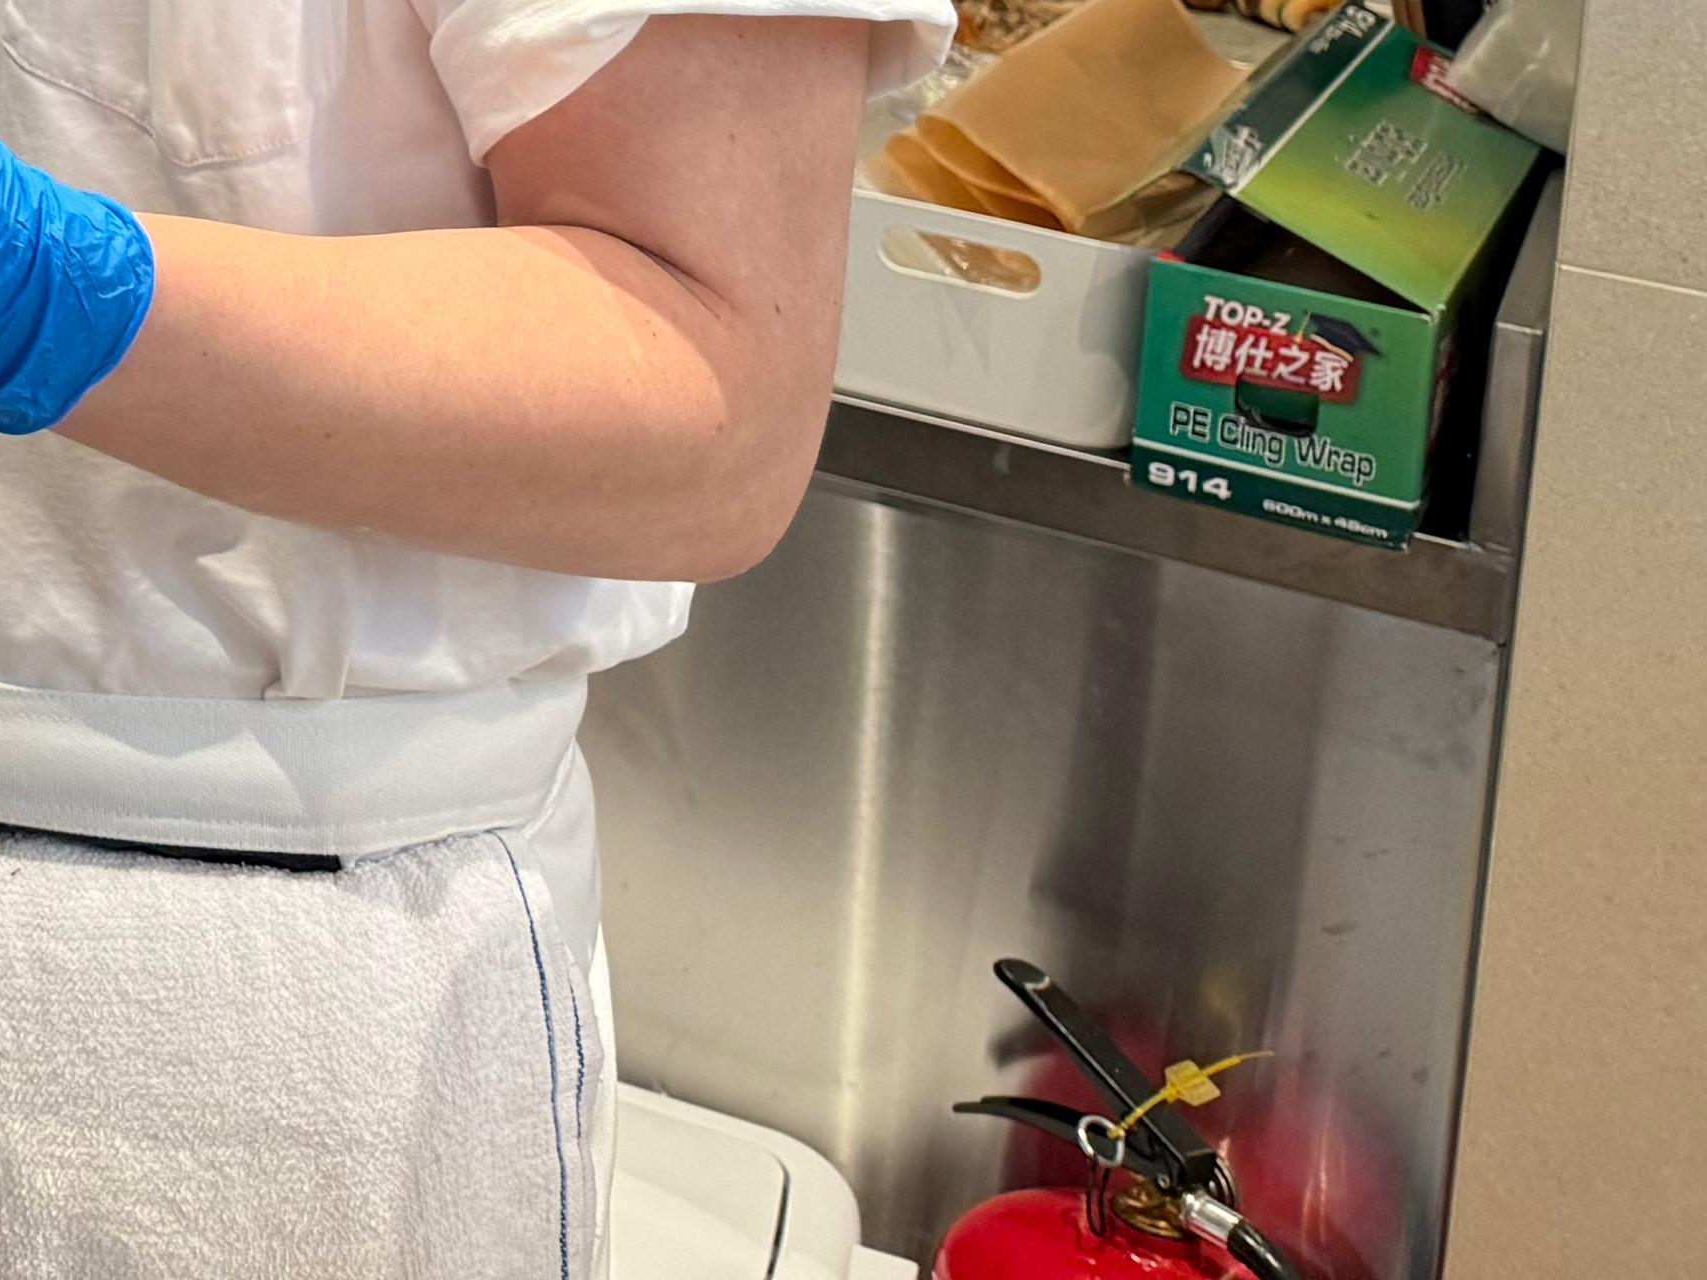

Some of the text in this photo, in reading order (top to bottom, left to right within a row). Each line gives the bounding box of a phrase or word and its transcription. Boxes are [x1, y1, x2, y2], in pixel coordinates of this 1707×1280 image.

[1204, 295, 1292, 335] TOP-Z
[1192, 324, 1350, 393] 博仕之家
[1169, 401, 1376, 486] PE Cling Wrap
[1148, 461, 1232, 500] 914
